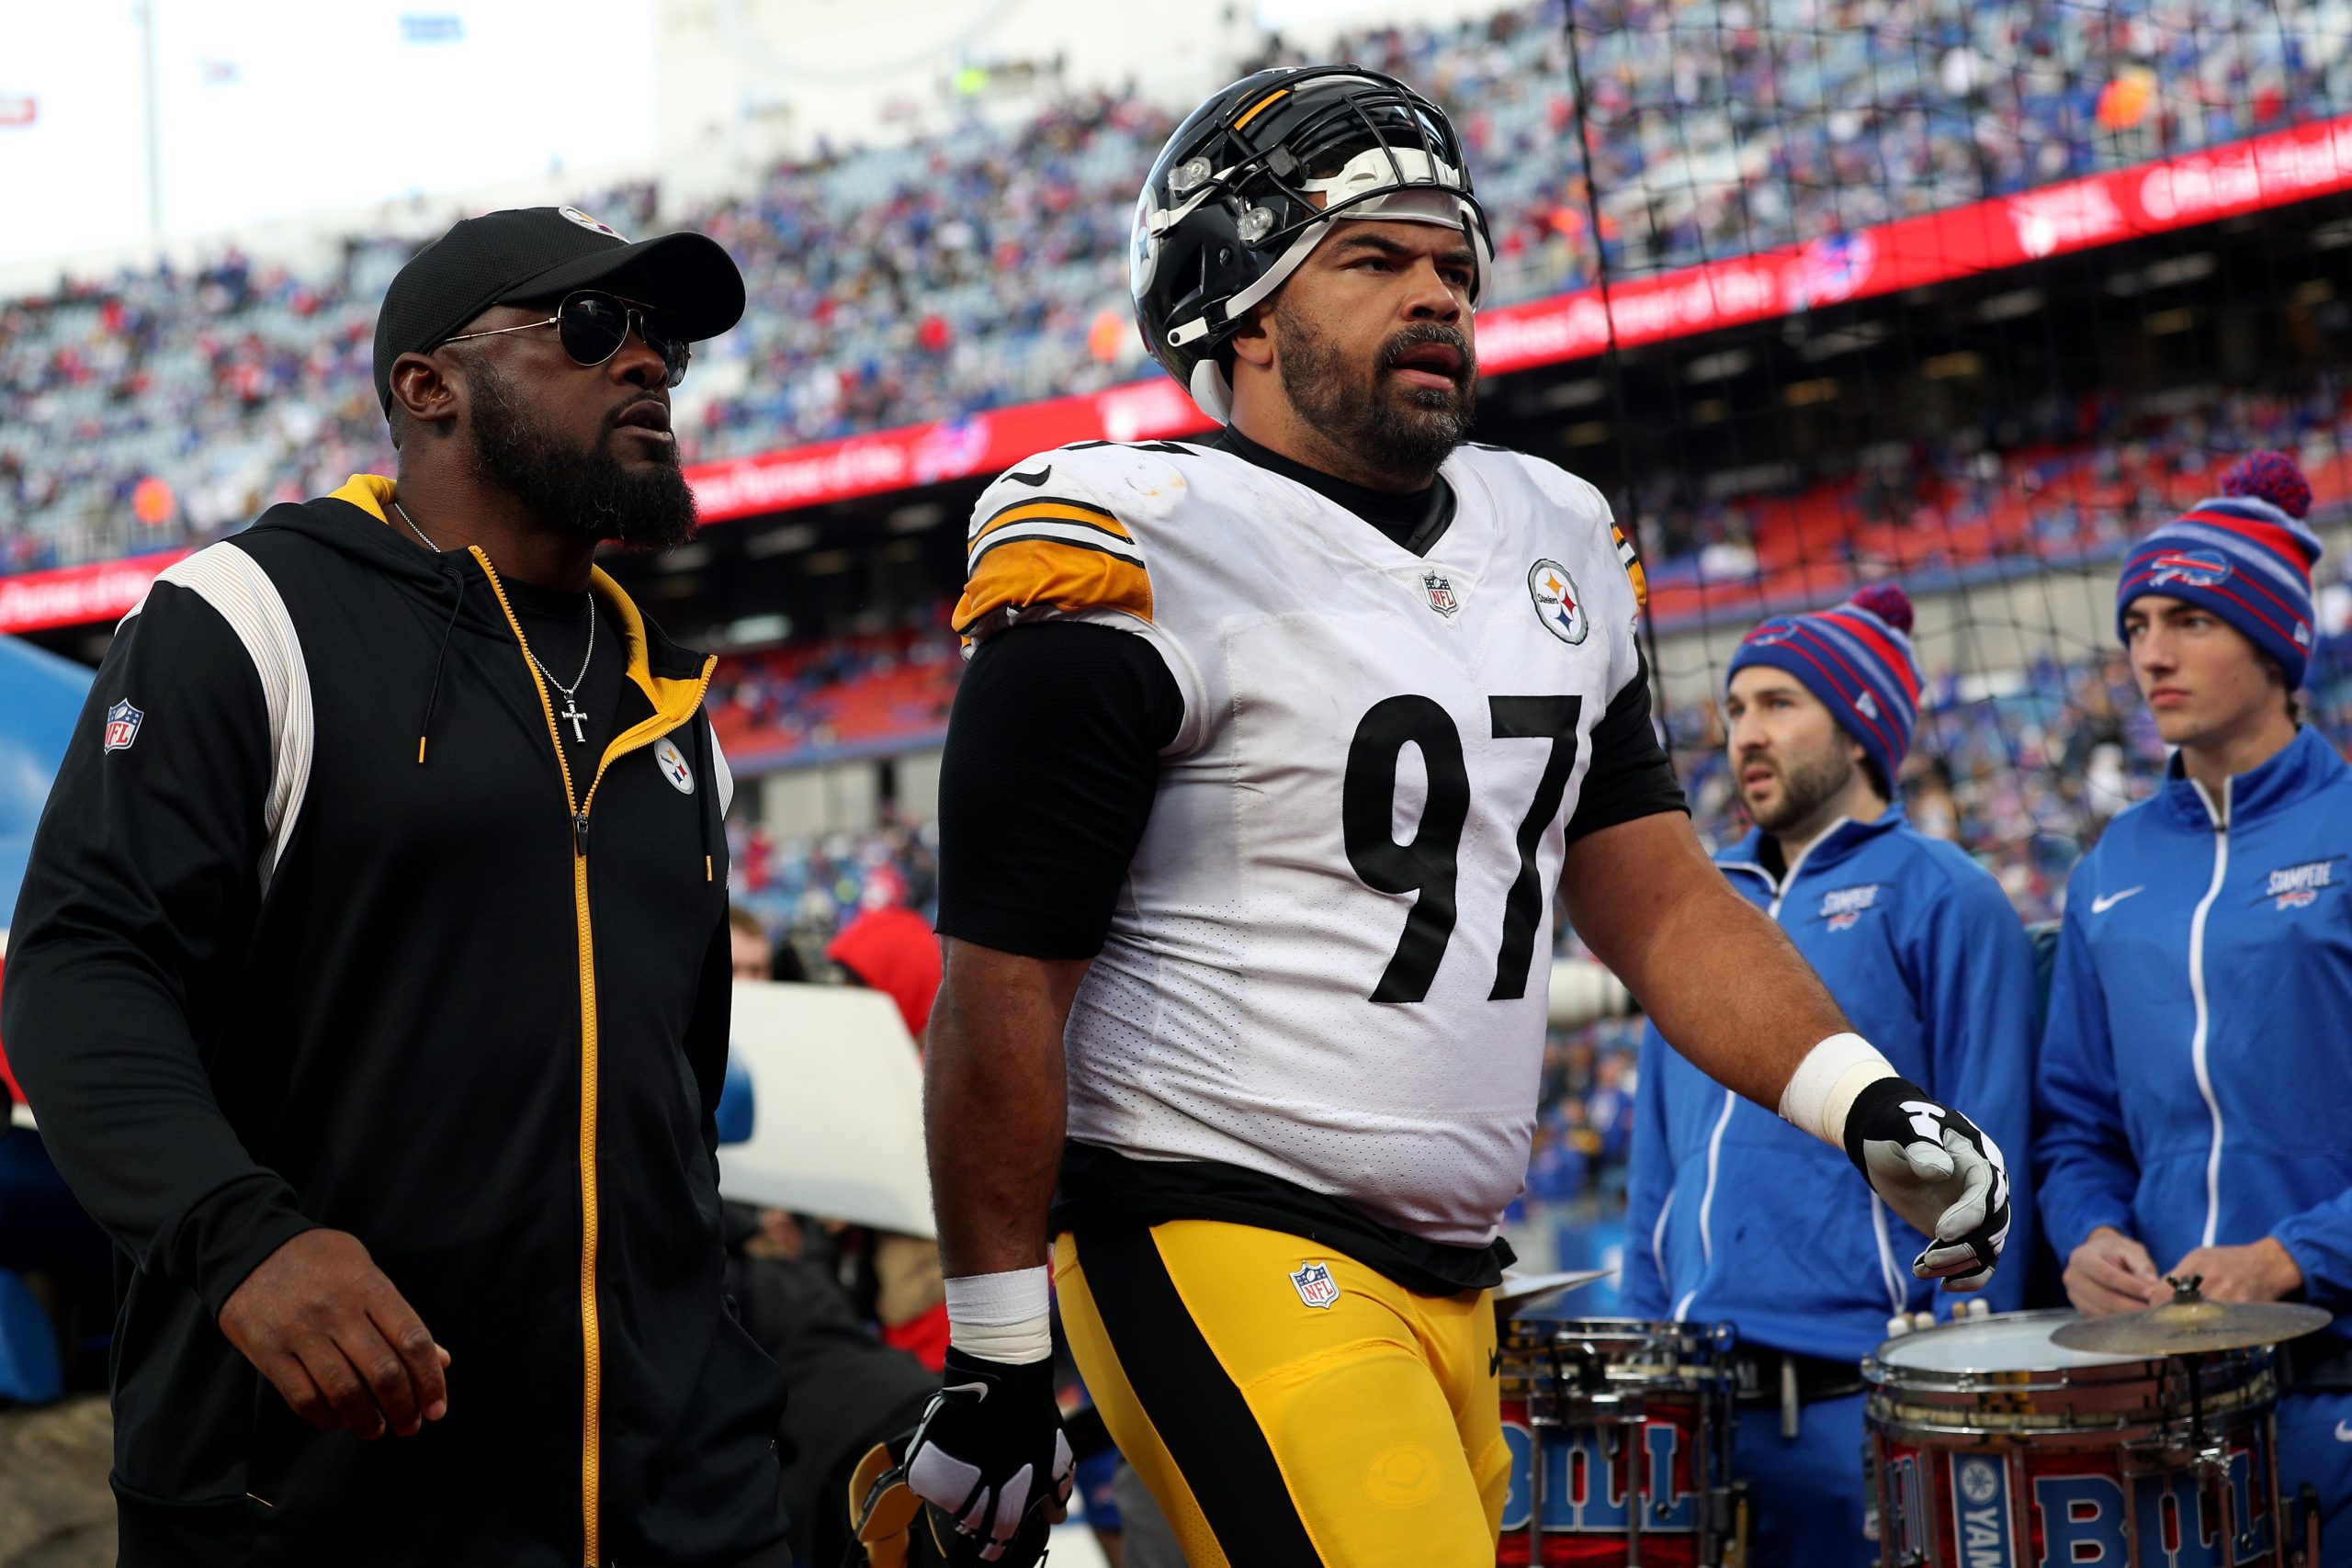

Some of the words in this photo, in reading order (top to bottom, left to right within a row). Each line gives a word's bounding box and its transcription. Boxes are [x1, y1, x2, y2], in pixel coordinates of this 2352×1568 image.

[1430, 590, 1454, 607] NFL
[1341, 694, 1583, 1003] 97
[2266, 861, 2333, 896] STAMPEDE
[1303, 1280, 1334, 1301] NFL
